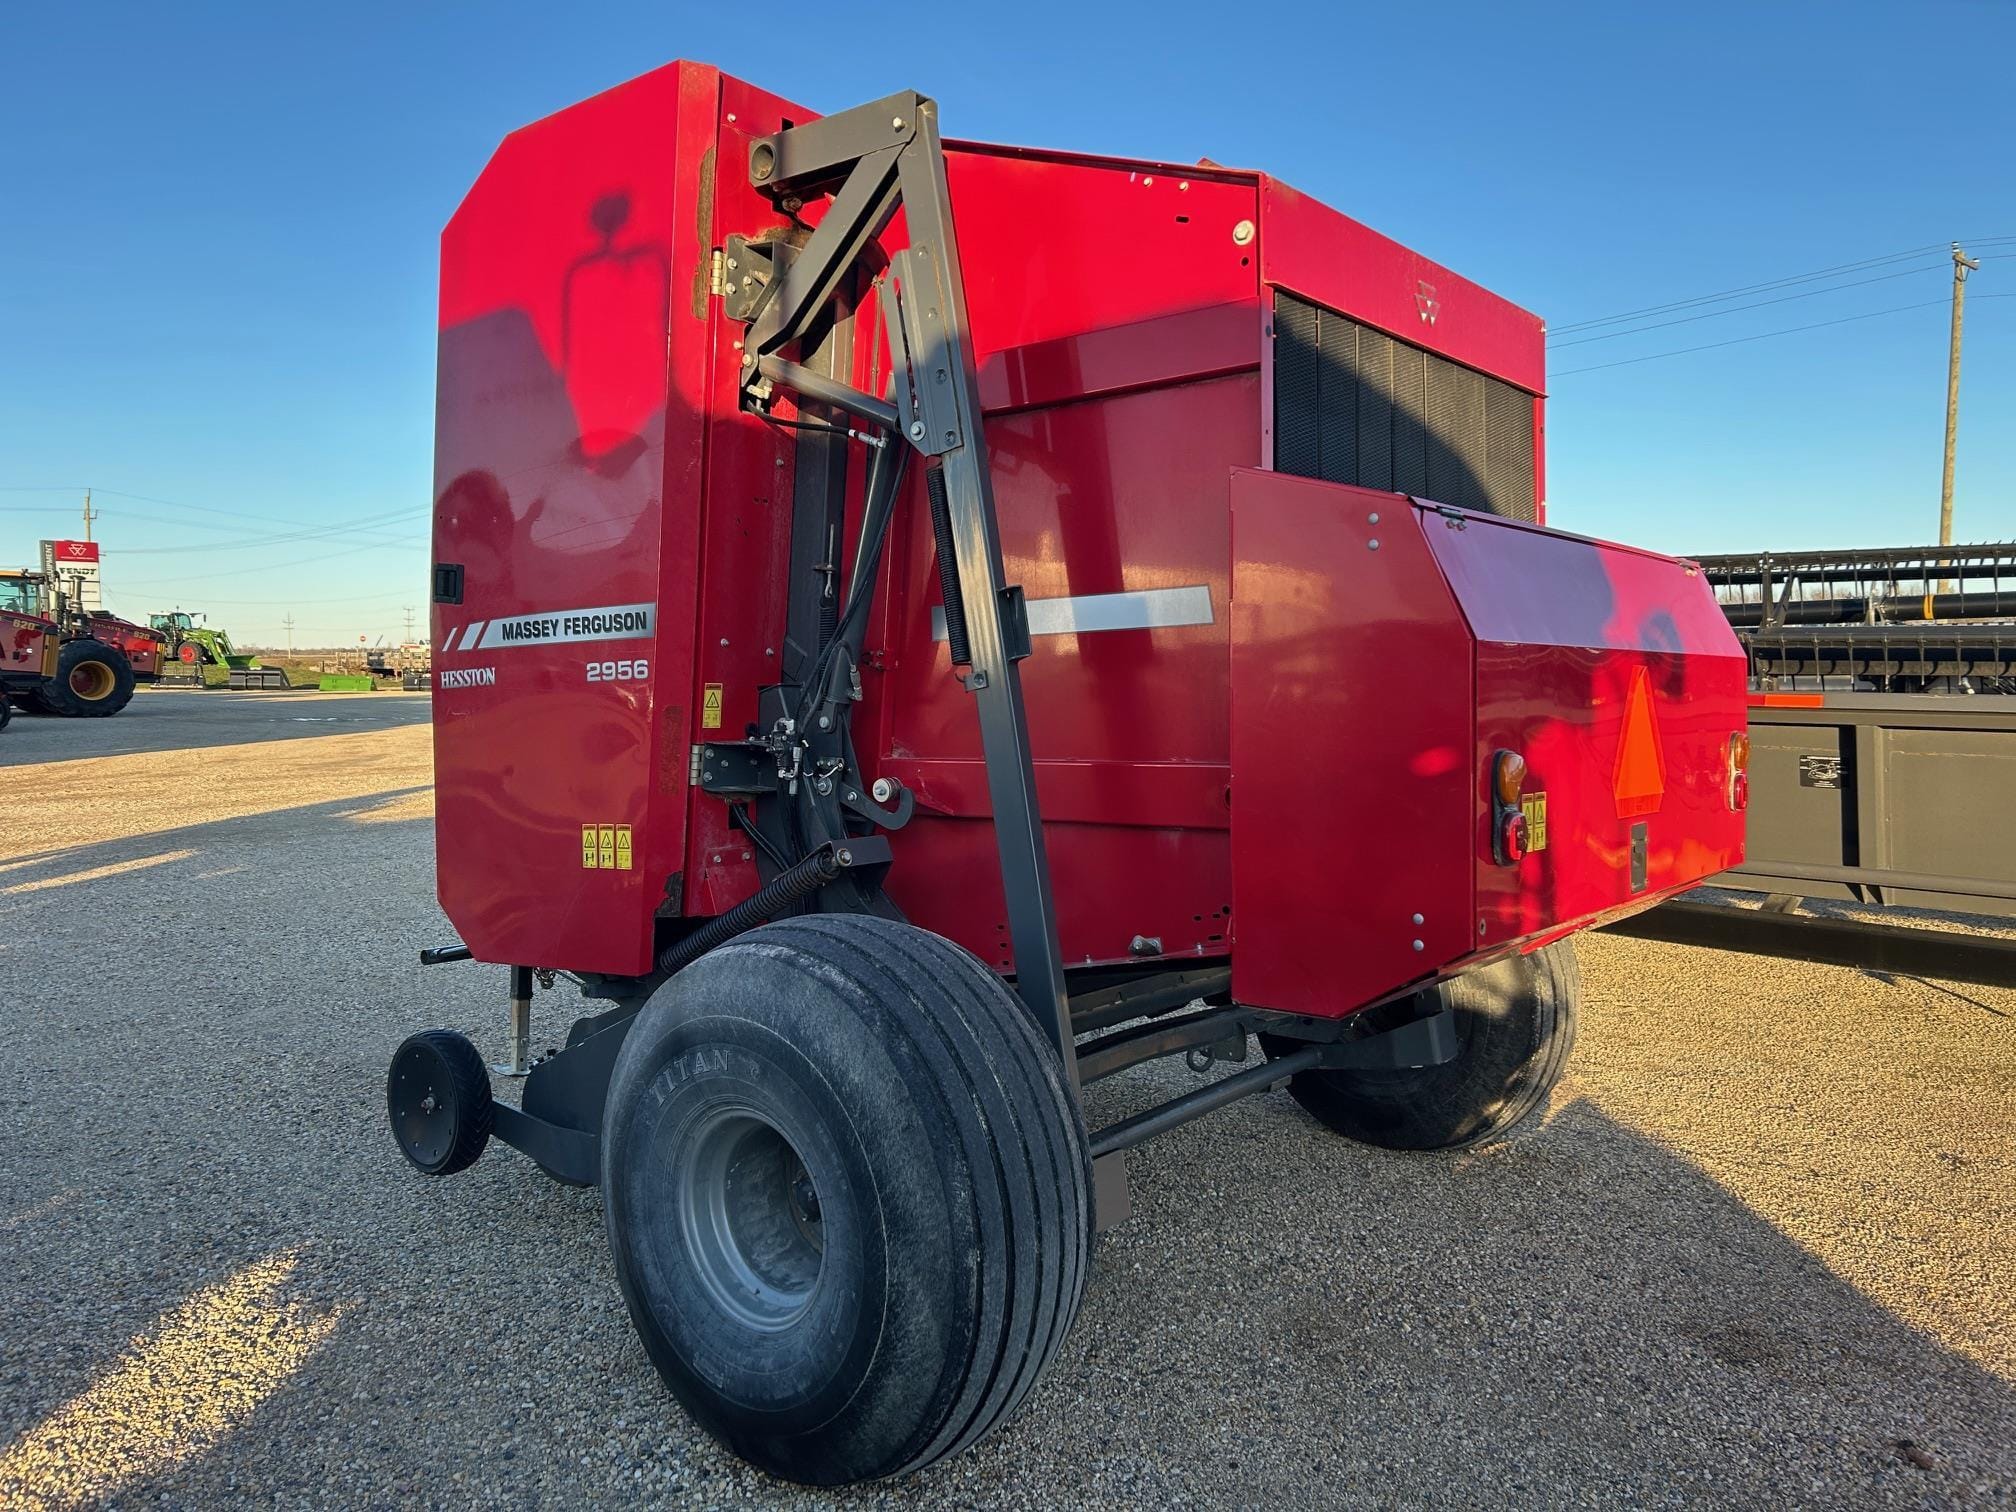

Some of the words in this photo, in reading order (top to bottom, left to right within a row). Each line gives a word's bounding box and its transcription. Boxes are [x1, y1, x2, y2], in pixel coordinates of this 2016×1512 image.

[59, 567, 97, 575] FENDT
[12, 619, 36, 631] 620
[502, 618, 559, 641] MASSEY
[564, 611, 647, 636] FERGUSON
[440, 667, 496, 689] HESSTON
[586, 659, 649, 682] 2956
[648, 1049, 733, 1108] TITAN
